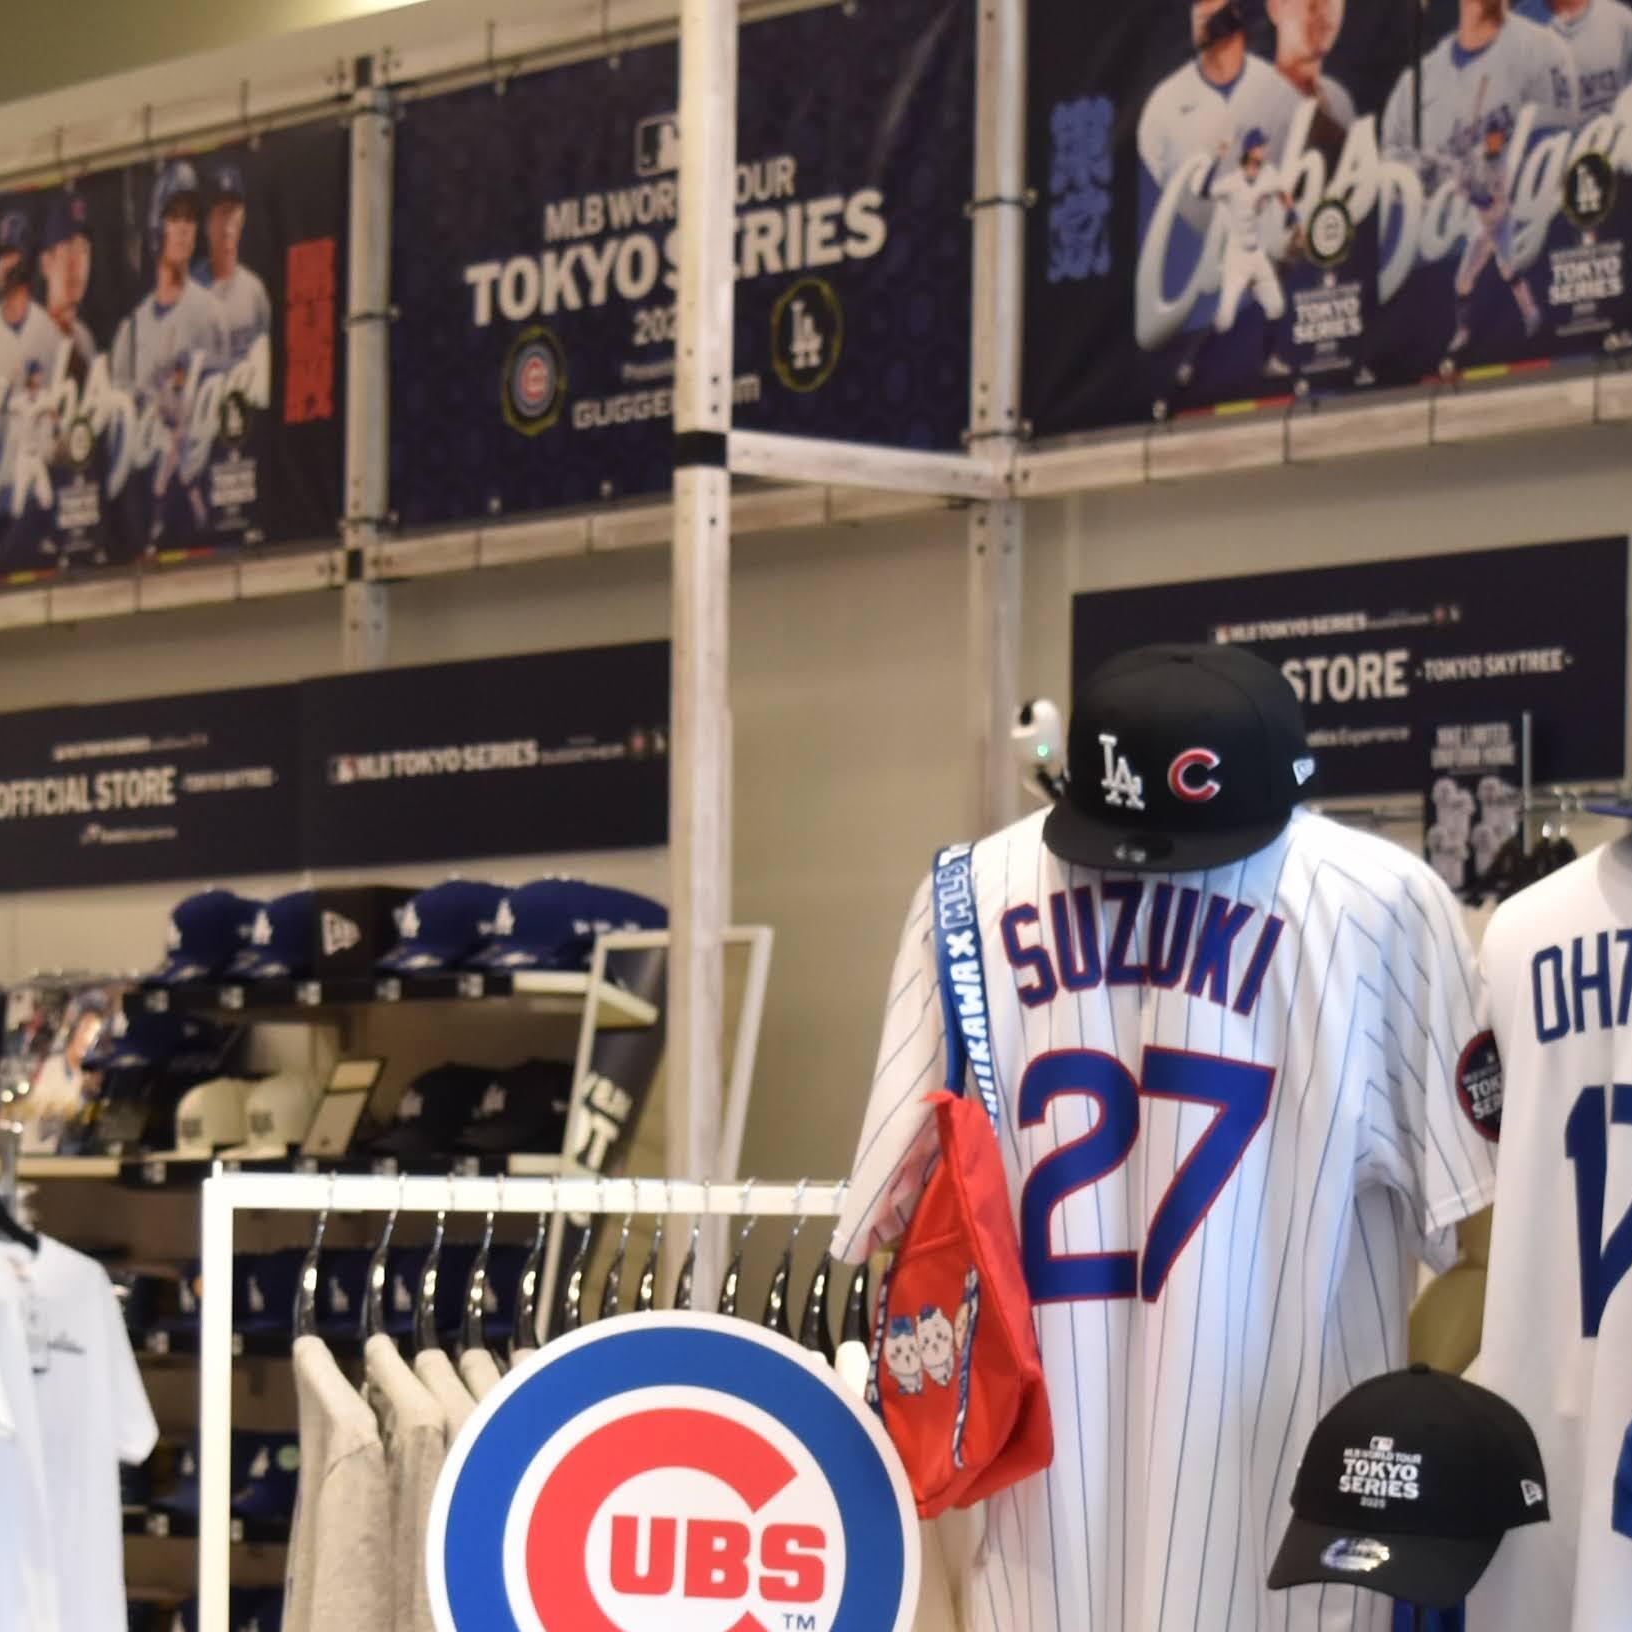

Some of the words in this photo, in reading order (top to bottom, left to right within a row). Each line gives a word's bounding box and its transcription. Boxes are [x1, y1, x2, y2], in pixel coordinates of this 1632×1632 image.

[545, 194, 603, 241] MLB
[607, 181, 677, 227] WOR
[733, 154, 796, 200] OUR
[463, 233, 657, 327] TOKYO
[665, 188, 887, 291] RIES
[633, 306, 677, 346] 202
[1281, 648, 1410, 704] STORE
[95, 765, 177, 811] STORE
[1098, 732, 1146, 811] LA
[1168, 747, 1221, 802] C
[999, 879, 1286, 1017] SUZUKI
[1018, 1044, 1277, 1306] 27
[1343, 1458, 1418, 1481] TOKYO
[1395, 1452, 1423, 1465] TOUR
[1338, 1475, 1420, 1500] SERIES
[782, 1613, 817, 1632] TM
